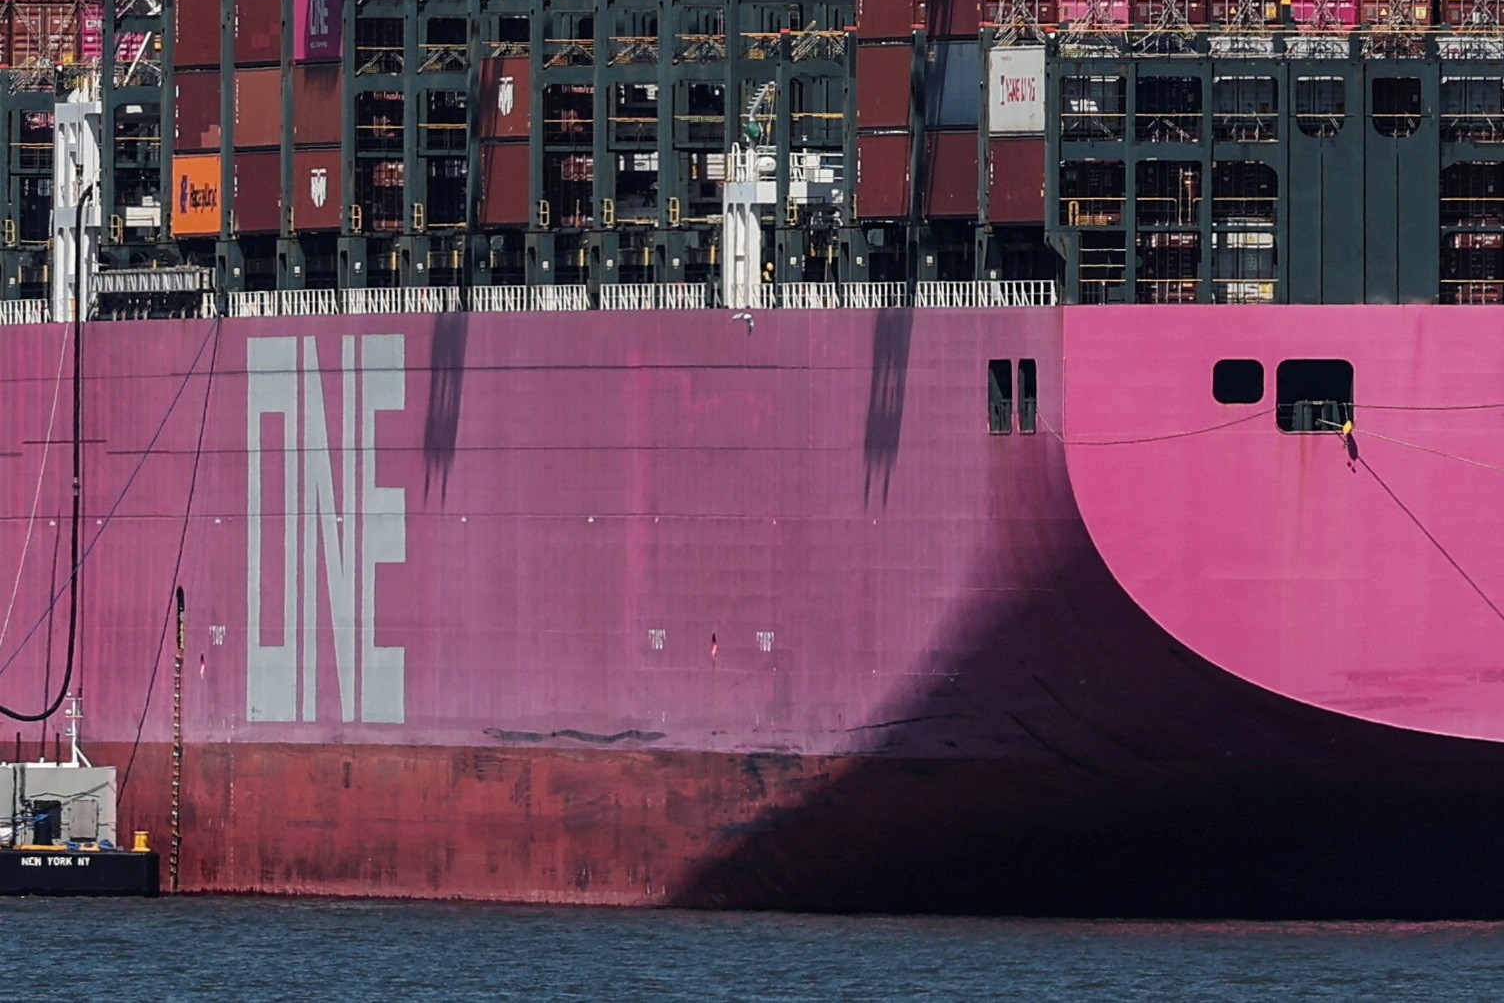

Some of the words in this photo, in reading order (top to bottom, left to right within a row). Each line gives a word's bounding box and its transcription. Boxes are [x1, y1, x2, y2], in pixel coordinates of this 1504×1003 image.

[247, 333, 406, 723] ONE
[47, 857, 72, 867] YORK
[78, 857, 91, 867] NY
